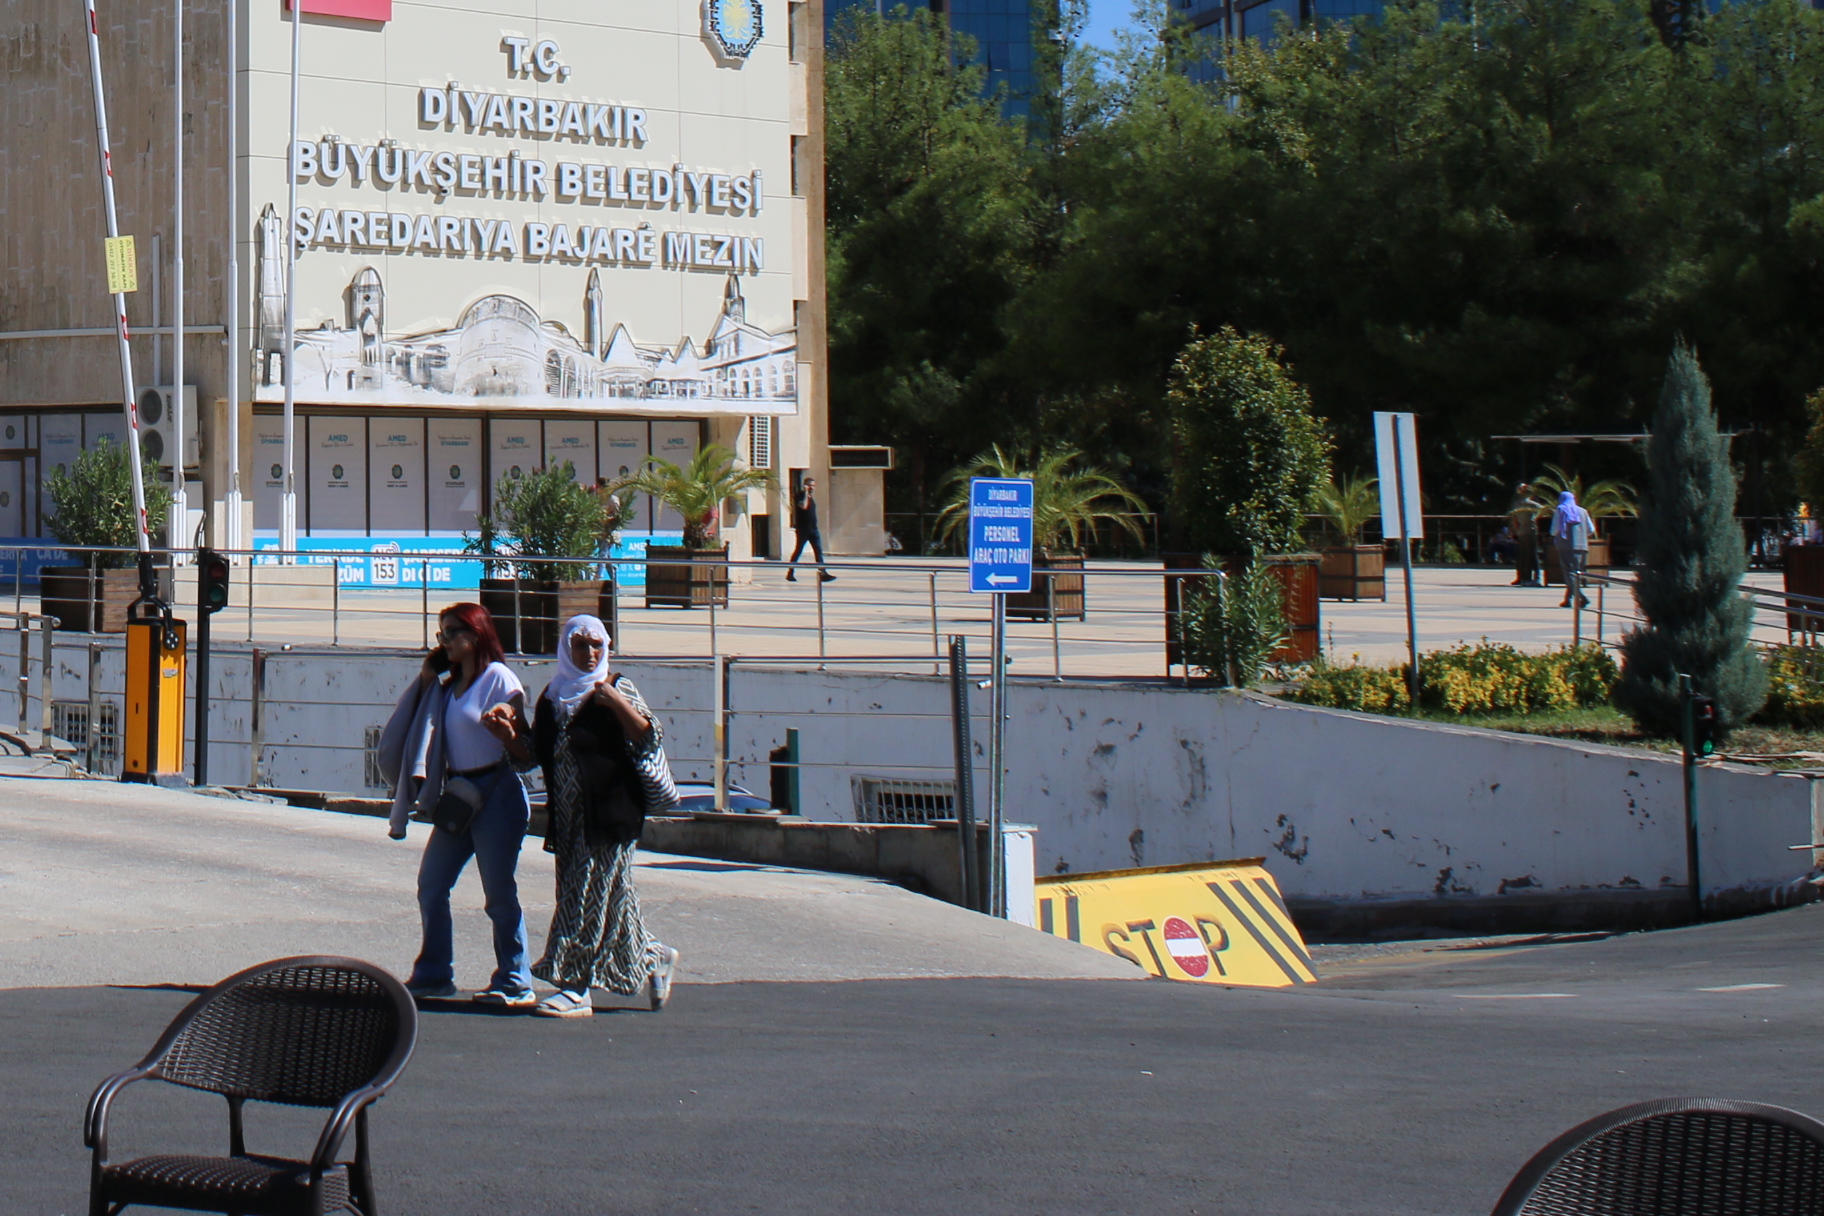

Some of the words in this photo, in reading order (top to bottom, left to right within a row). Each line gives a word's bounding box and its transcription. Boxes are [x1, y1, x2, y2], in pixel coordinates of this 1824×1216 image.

[501, 36, 572, 77] T.C.
[420, 81, 649, 143] DİYARBAKIR
[294, 134, 549, 197] BÜYÜKŞEHİR
[558, 162, 764, 211] BELEDİYESİ
[294, 206, 519, 254] ŞAREDARIYA
[527, 221, 657, 263] BAJARÊ
[665, 231, 765, 269] MEZIN
[628, 542, 647, 551] AME
[984, 525, 1020, 542] PERSONEL
[973, 547, 993, 565] ARAÇ
[993, 547, 1008, 564] OTO
[373, 563, 395, 579] 153
[433, 567, 452, 582] DE
